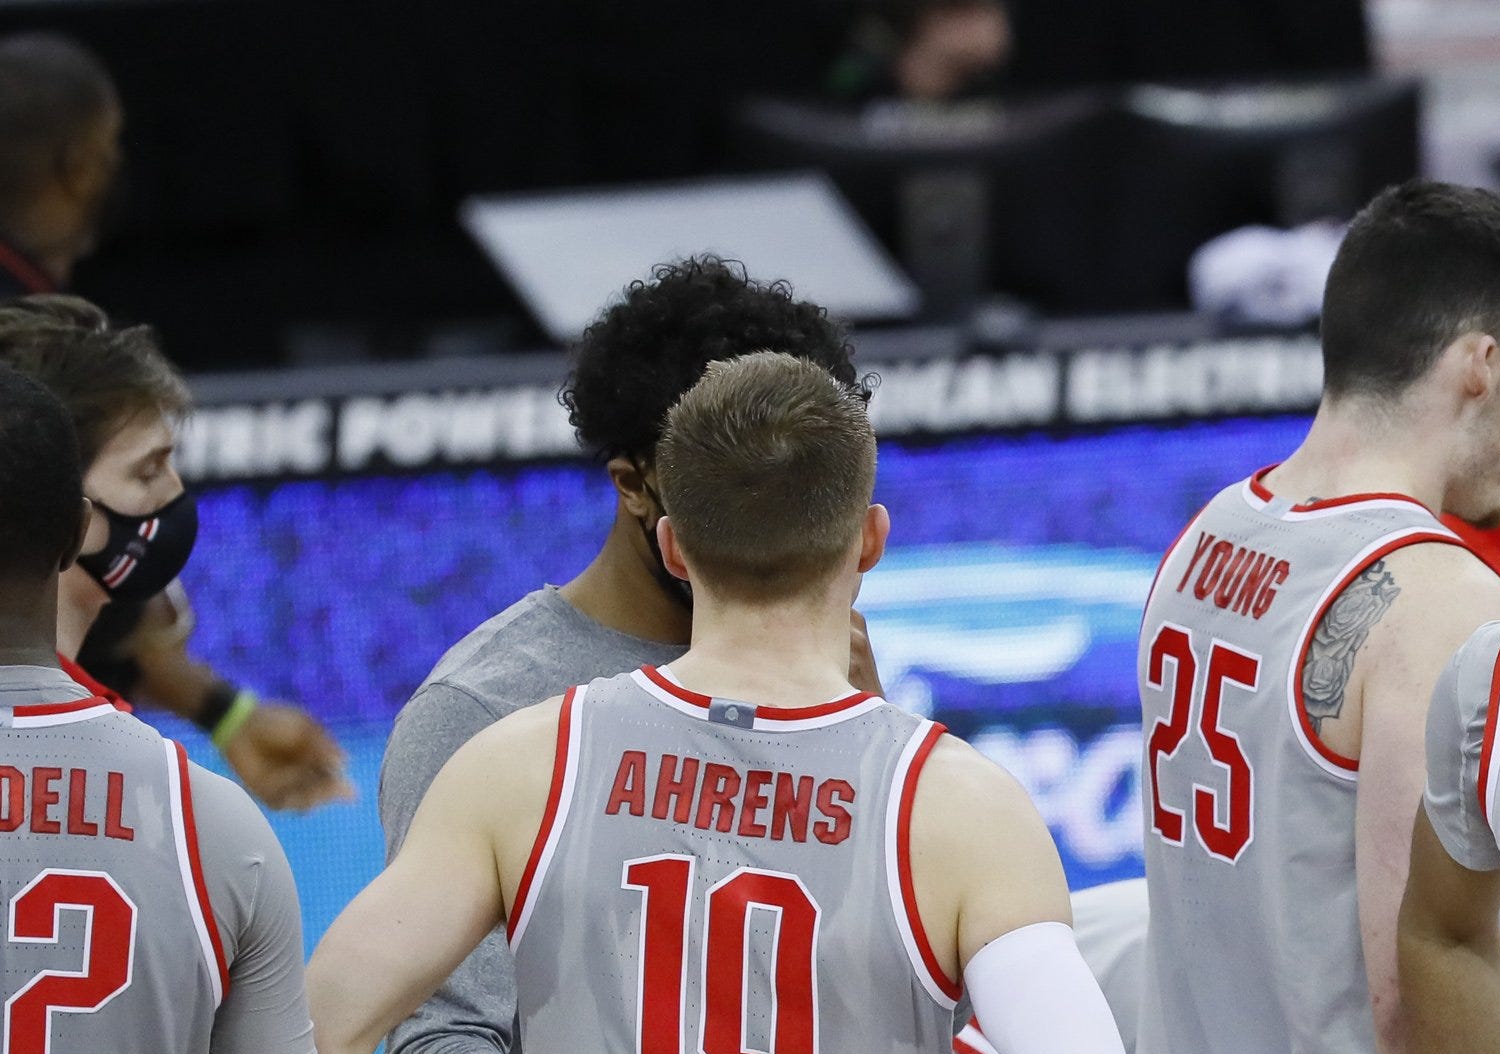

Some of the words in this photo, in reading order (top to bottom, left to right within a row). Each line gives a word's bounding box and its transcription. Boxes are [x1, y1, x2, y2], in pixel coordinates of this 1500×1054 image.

[1176, 531, 1290, 620] YOUNG
[1146, 621, 1262, 865] 25
[0, 765, 135, 842] DELL
[605, 750, 856, 845] AHRENS
